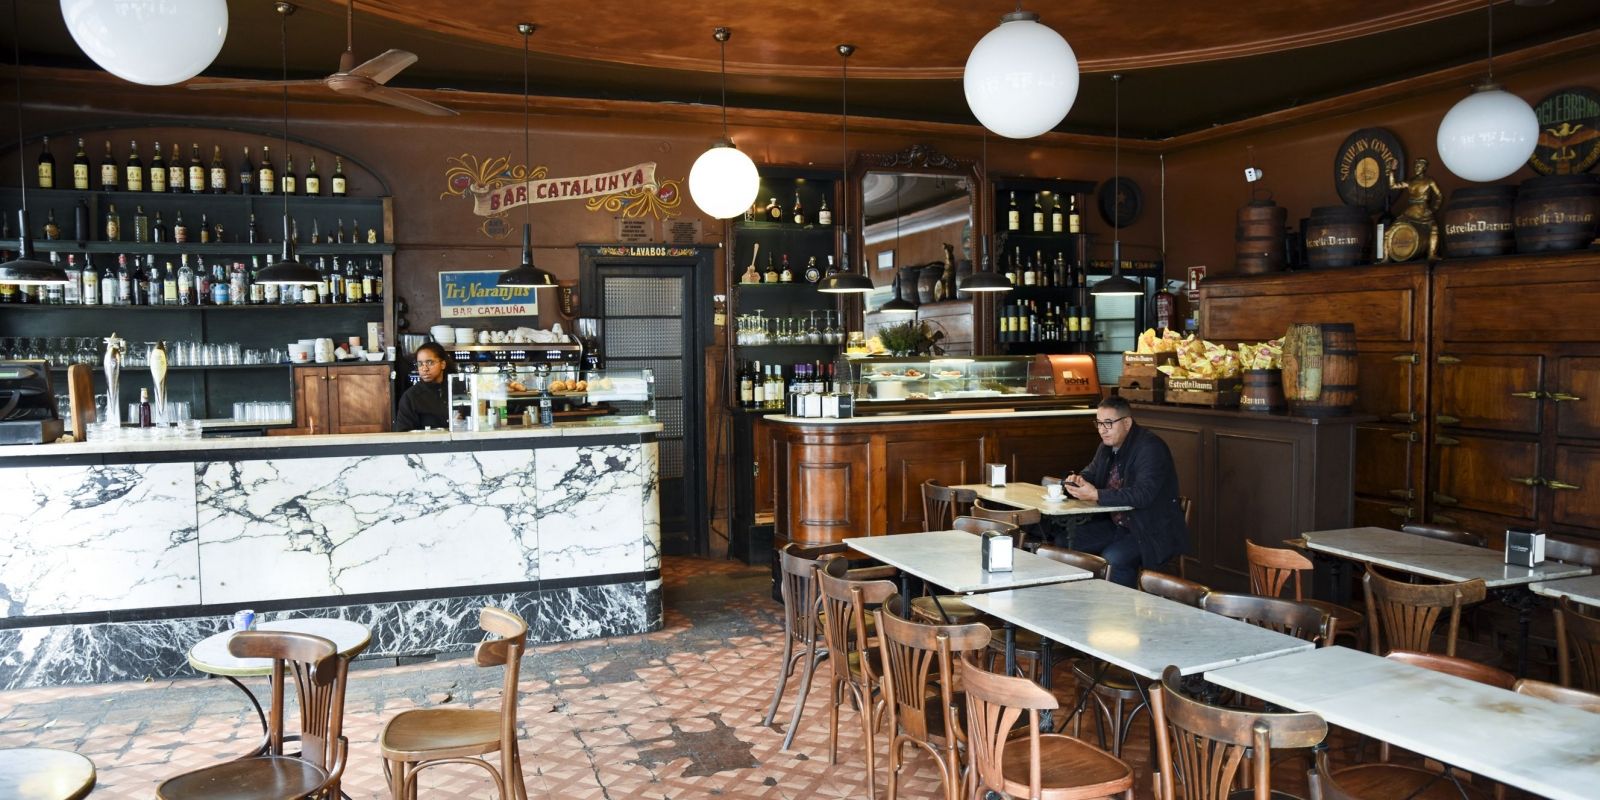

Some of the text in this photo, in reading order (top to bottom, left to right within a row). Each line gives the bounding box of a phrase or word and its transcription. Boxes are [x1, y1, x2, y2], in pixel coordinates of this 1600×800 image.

[490, 168, 644, 211] BAR CATALUNYA
[630, 247, 666, 257] LAVABOS
[446, 283, 466, 299] Tri
[452, 304, 526, 315] BAR CATALUÑA
